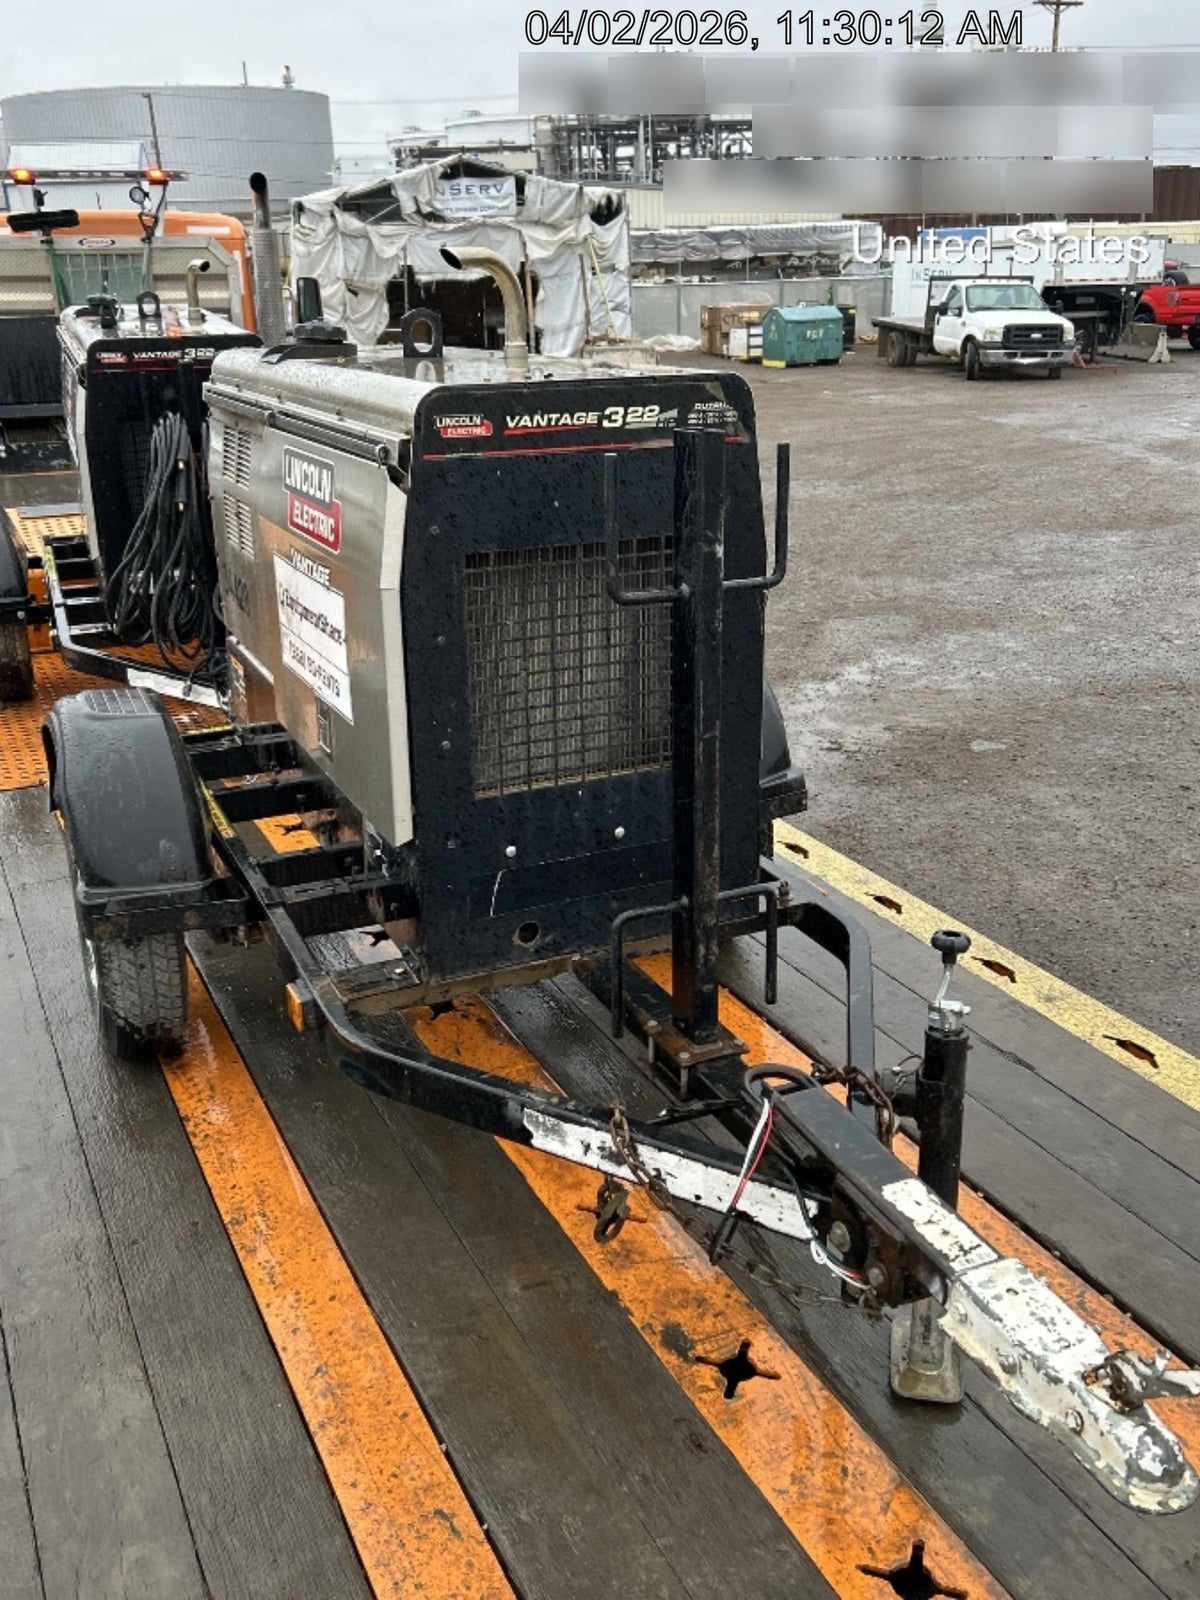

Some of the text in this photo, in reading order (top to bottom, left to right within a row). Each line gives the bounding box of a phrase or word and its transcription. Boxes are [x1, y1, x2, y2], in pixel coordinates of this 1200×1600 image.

[436, 415, 481, 428] LINCOLN
[505, 411, 598, 428] VANTAGE
[602, 404, 660, 428] 322
[285, 453, 332, 503] LINCOLN
[293, 501, 336, 542] ELECTRIC
[290, 548, 330, 585] VANTAGE
